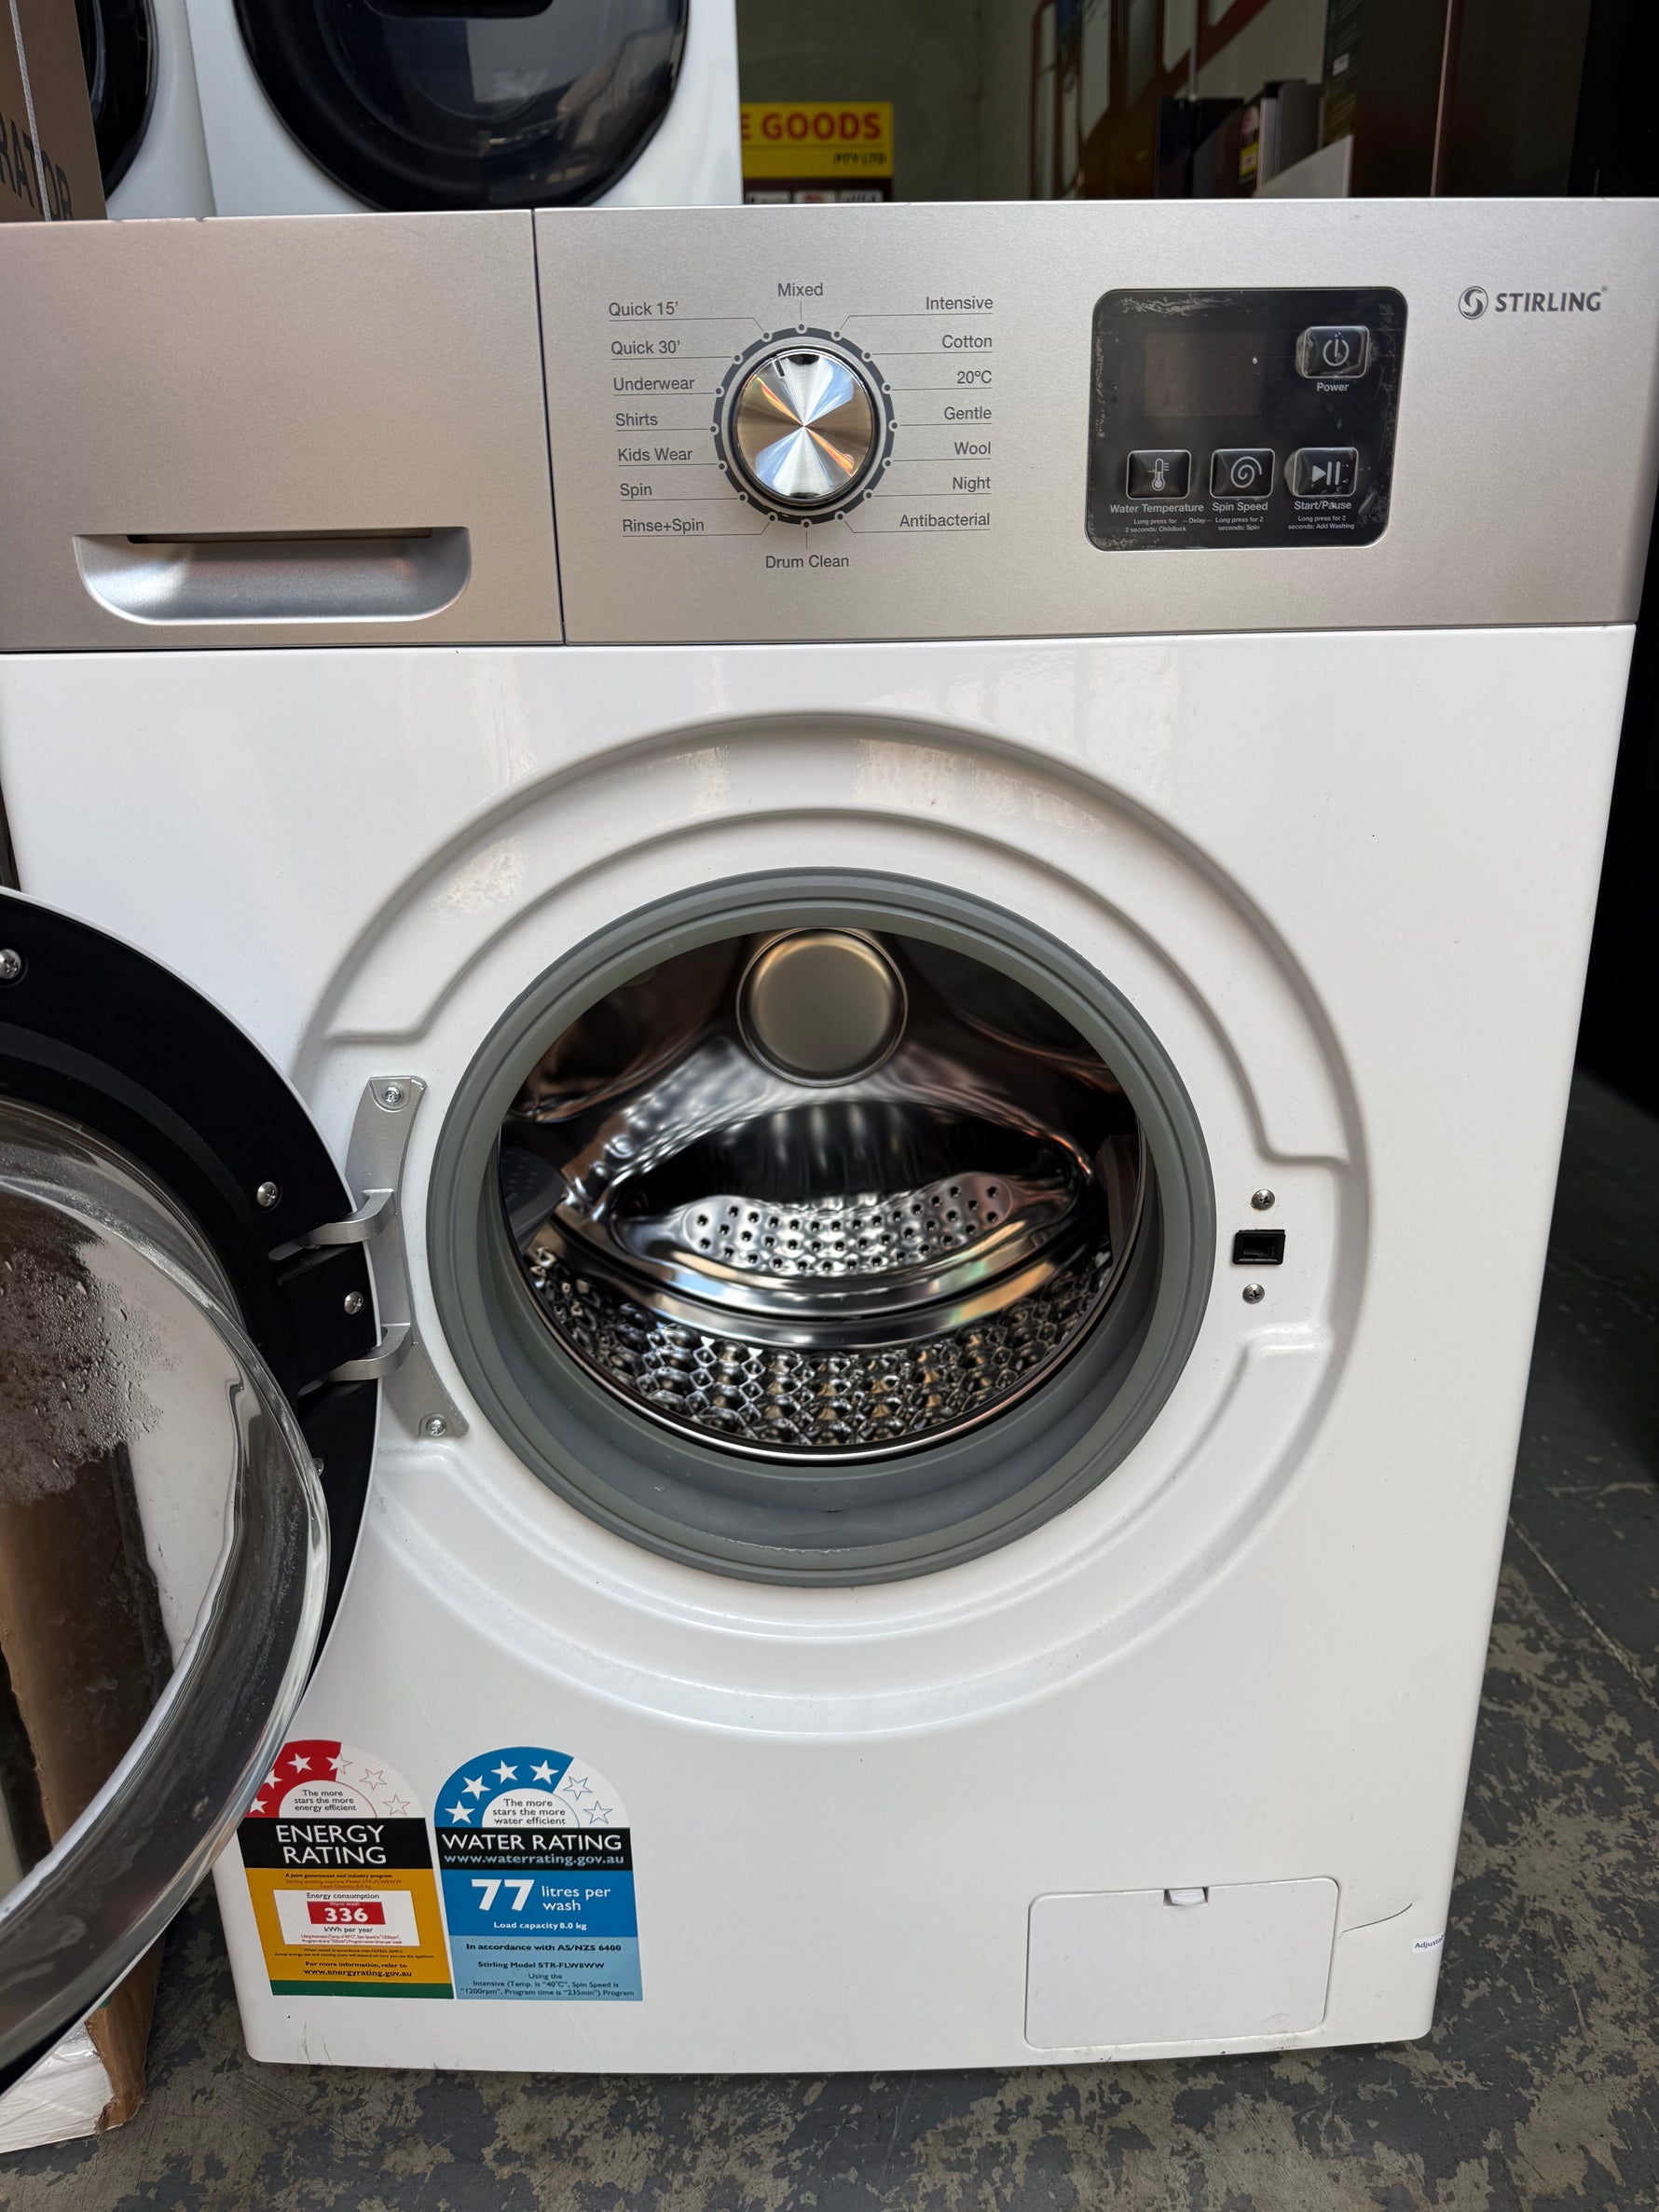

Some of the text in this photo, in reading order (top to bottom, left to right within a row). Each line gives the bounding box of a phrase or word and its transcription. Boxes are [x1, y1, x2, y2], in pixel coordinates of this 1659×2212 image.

[762, 113, 881, 140] GOODS
[777, 282, 824, 297] Mixed
[609, 302, 652, 317] Quick
[925, 296, 994, 310] Intensive
[611, 341, 654, 355] Quick
[942, 335, 993, 349] Cotton
[613, 377, 695, 392] Underwear
[1316, 382, 1350, 392] Power
[615, 412, 658, 427] Shirts
[943, 406, 992, 420] Gentle
[618, 447, 693, 461] Kids Wear
[954, 441, 992, 455] Wool
[620, 483, 652, 499] Spin
[953, 476, 992, 492] Night
[1110, 503, 1205, 514] Water Temperature
[1212, 502, 1268, 513] Spin Speed
[1294, 501, 1352, 511] Start/Pause
[623, 518, 705, 534] Rinse+Spin
[899, 513, 991, 528] Antibacterial
[765, 555, 850, 570] Drum Clean
[275, 1825, 384, 1843] ENERGY
[441, 1834, 622, 1851] WATER RATING
[283, 1846, 387, 1864] RATING
[444, 1854, 624, 1866] www.waterrating.gov.au
[471, 1879, 535, 1911] 77
[541, 1886, 611, 1901] litres per
[542, 1900, 581, 1911] wash
[324, 1907, 369, 1922] 336
